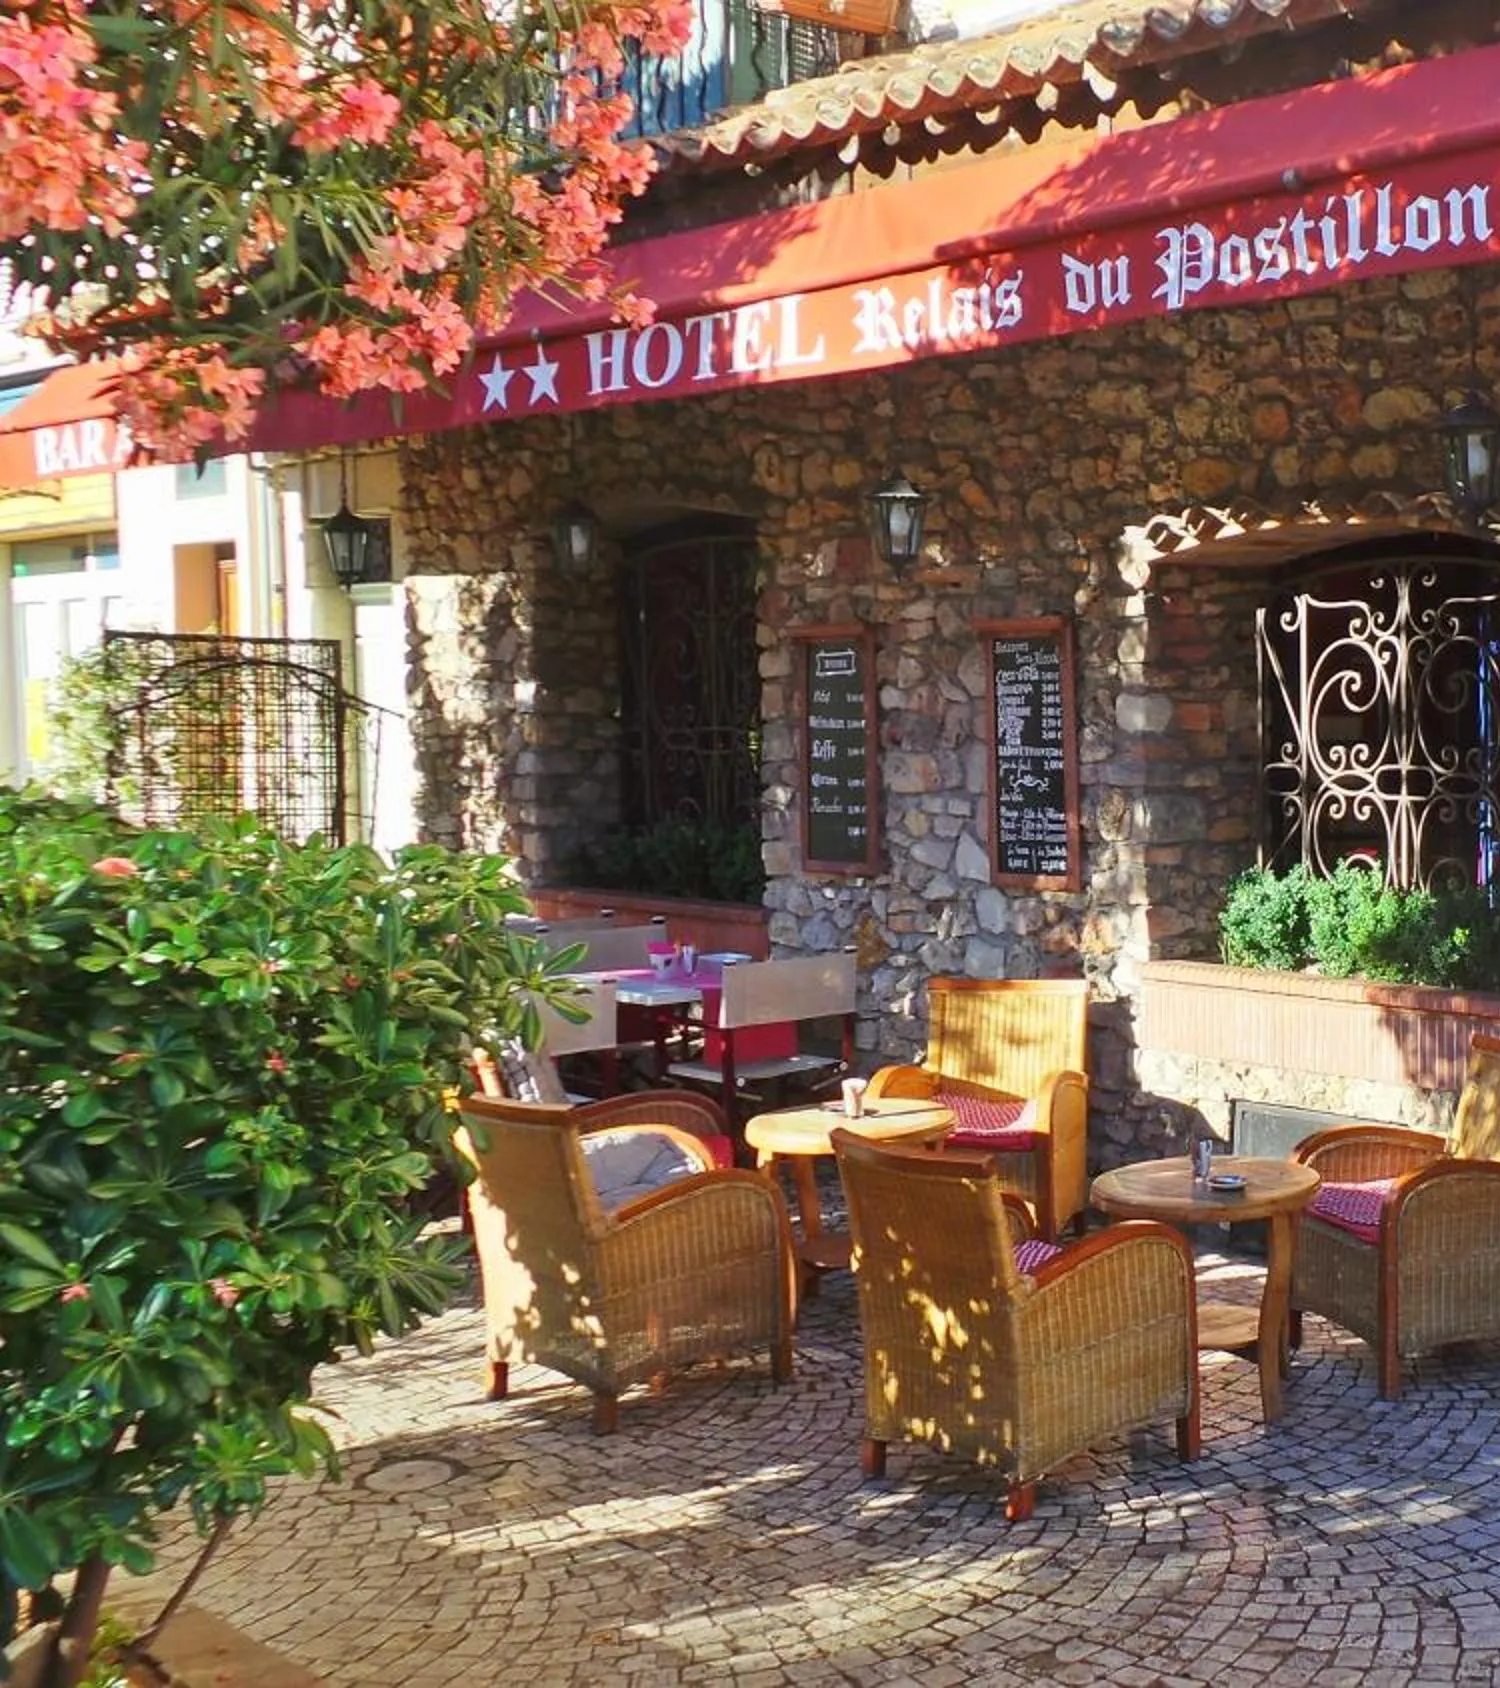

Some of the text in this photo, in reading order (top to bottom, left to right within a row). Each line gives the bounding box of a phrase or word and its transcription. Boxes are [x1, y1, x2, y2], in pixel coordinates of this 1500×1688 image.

[586, 181, 1494, 396] HOTEL Relais du Postillon
[34, 418, 108, 477] BAR
